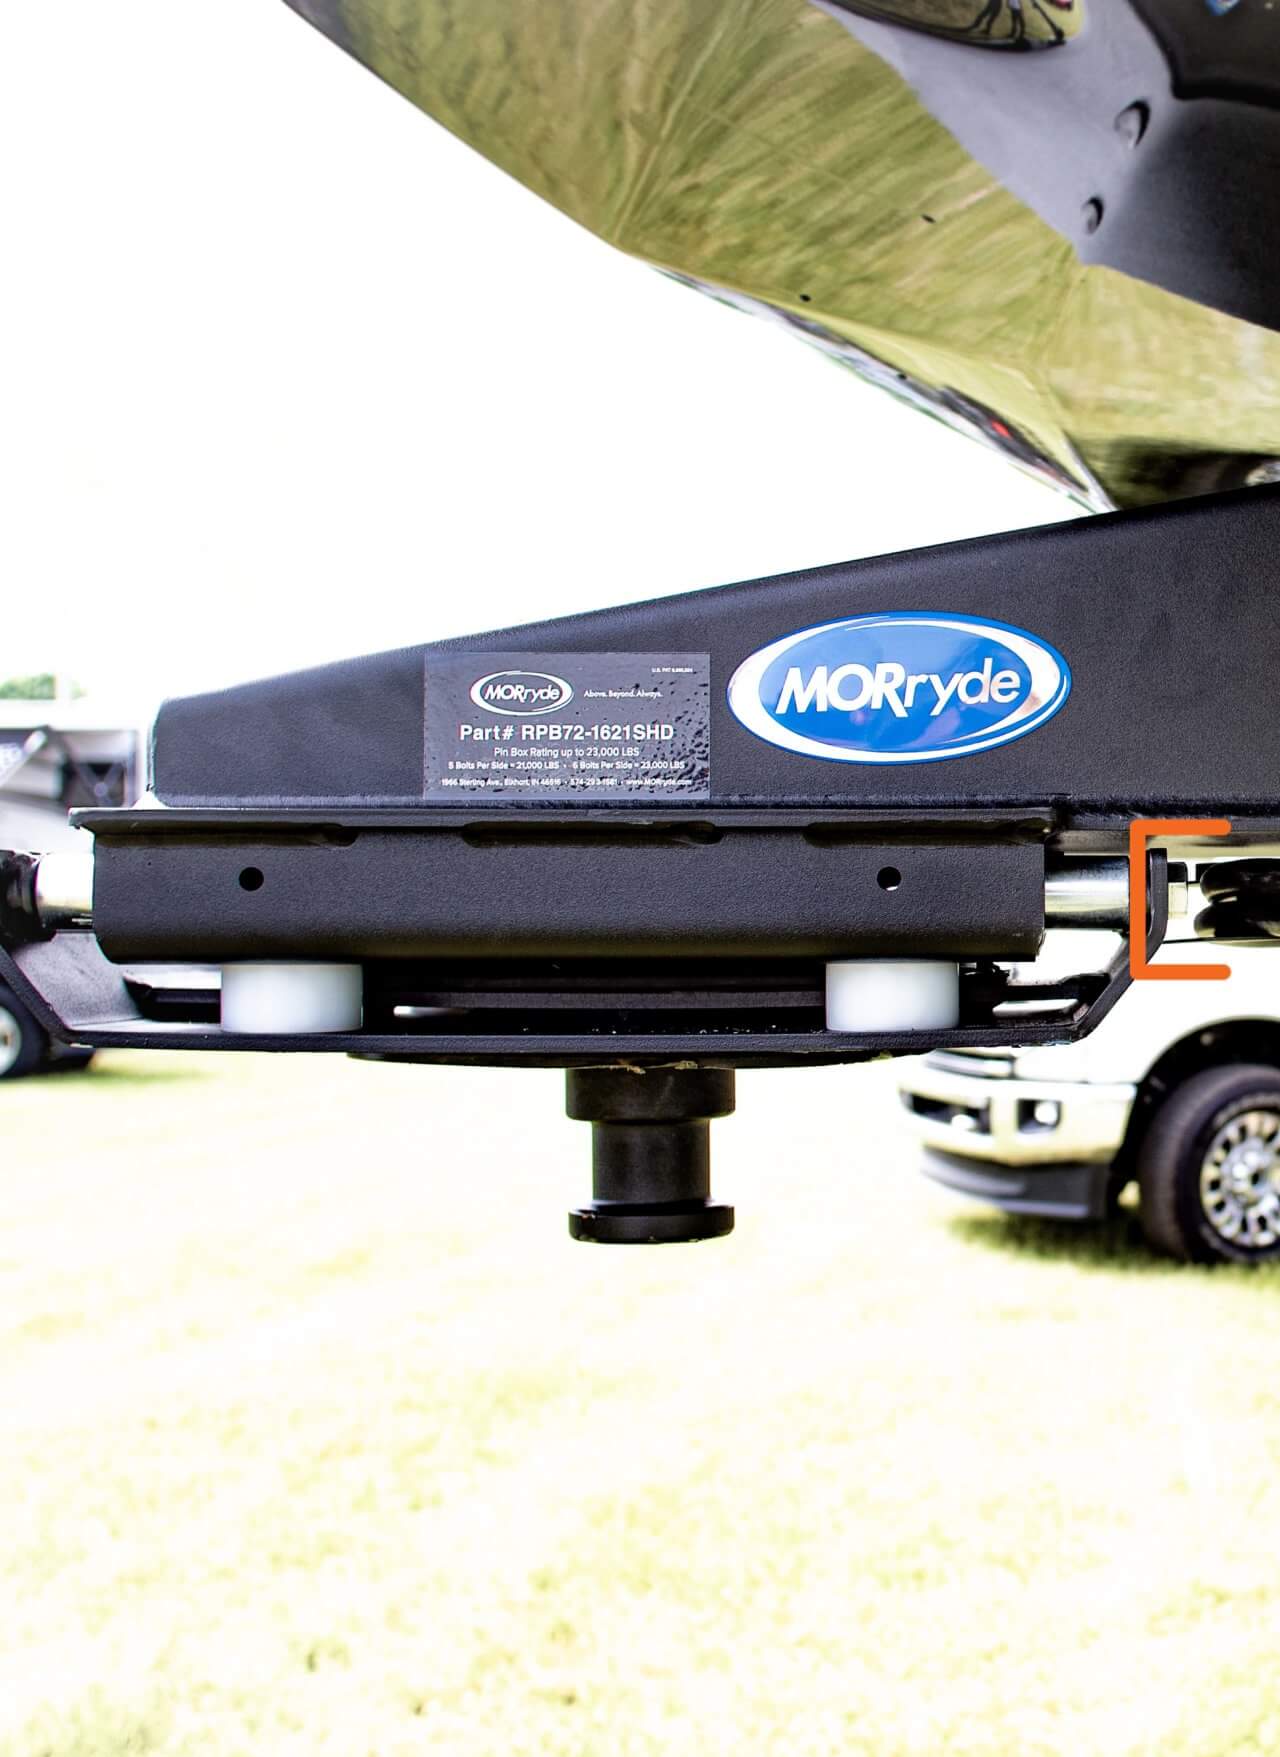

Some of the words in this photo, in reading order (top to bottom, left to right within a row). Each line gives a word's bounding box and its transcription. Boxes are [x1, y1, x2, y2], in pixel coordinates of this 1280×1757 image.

[775, 657, 1020, 718] MORryde
[484, 684, 560, 703] MORryde
[583, 689, 608, 698] Above.
[609, 689, 635, 699] Beyond.
[636, 689, 664, 699] Always.
[460, 724, 514, 741] Part#
[521, 723, 674, 741] RPB72-1621SHD
[494, 747, 509, 757] Pin
[511, 747, 529, 757] Box
[530, 747, 559, 758] Rating
[561, 748, 573, 758] up
[574, 748, 585, 757] to
[586, 747, 619, 757] 23,000
[621, 747, 640, 757] LBS
[455, 761, 475, 770] Bolts
[476, 761, 490, 770] Per
[491, 761, 509, 770] Side
[544, 761, 560, 770] LBS
[580, 761, 599, 770] Bolts
[600, 761, 614, 770] Per
[615, 761, 633, 770] Side
[669, 761, 686, 770] LBS
